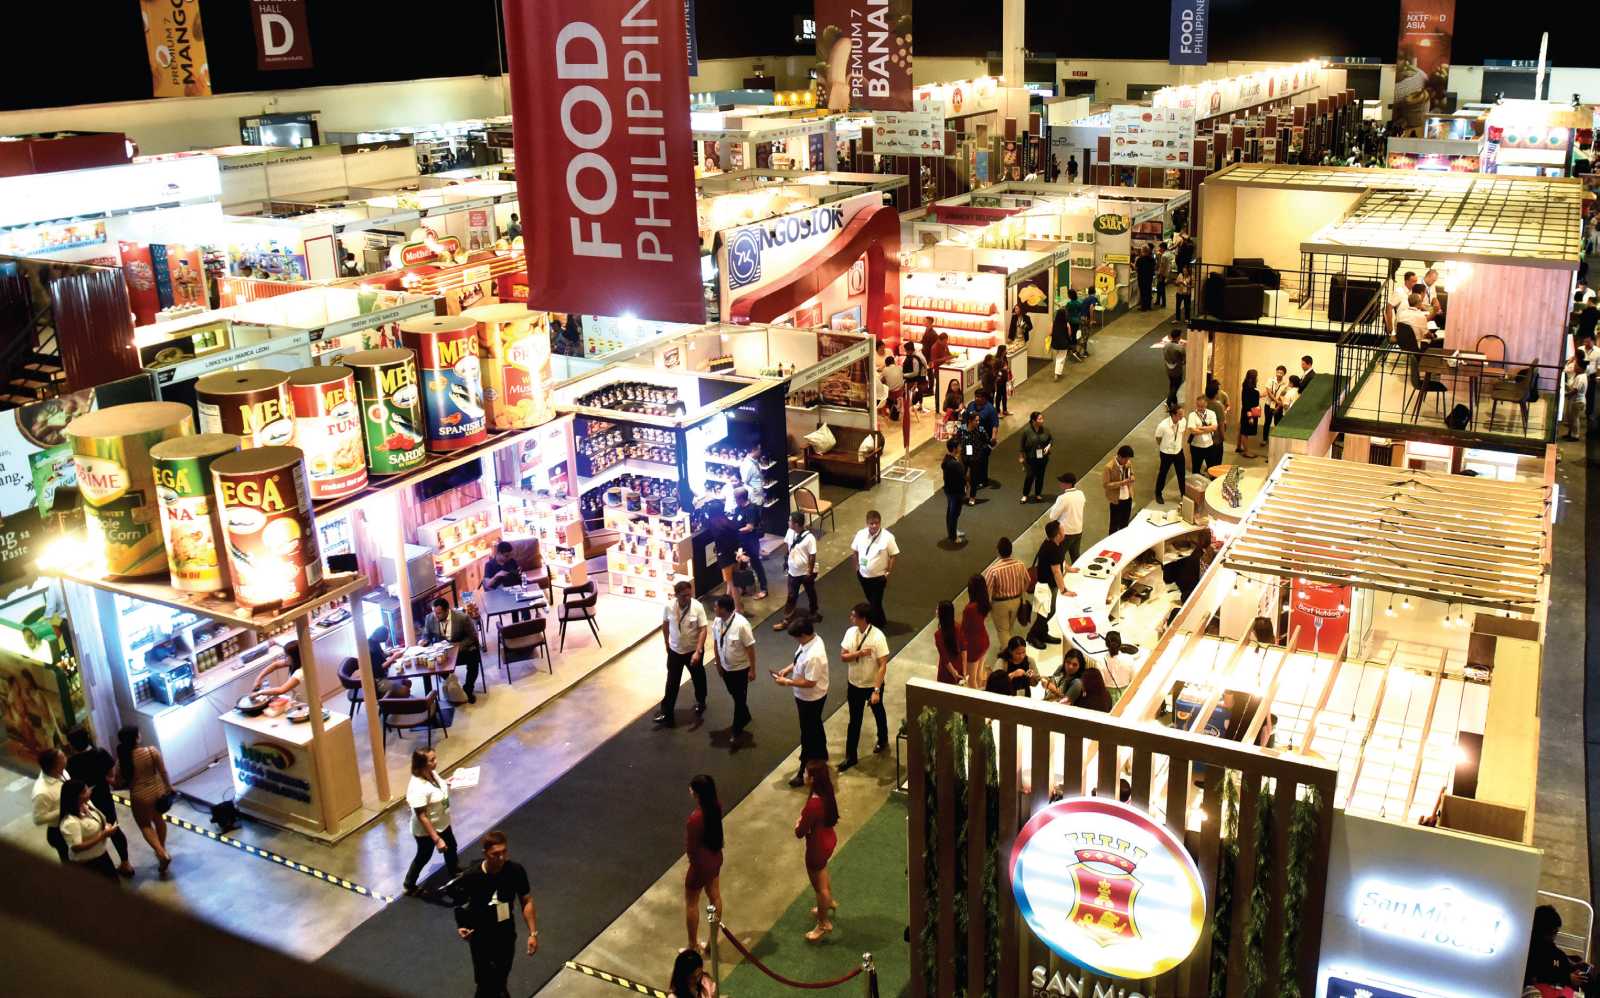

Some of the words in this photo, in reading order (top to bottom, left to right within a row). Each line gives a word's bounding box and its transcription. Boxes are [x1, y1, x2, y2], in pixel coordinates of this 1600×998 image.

[259, 4, 282, 13] HALL
[851, 9, 862, 17] 7
[1180, 9, 1194, 54] FOOD
[1406, 21, 1426, 29] ASIA
[260, 13, 294, 56] D
[866, 0, 890, 98] BANA
[851, 25, 863, 98] PREMIUM
[1345, 56, 1367, 64] EXIT
[1511, 59, 1536, 67] EXIT
[555, 21, 623, 259] FOOD
[759, 204, 844, 249] NGOSIOK
[322, 383, 356, 410] MEG
[240, 396, 294, 434] MEG
[438, 420, 481, 436] SPANISH
[168, 508, 194, 521] NA
[102, 517, 121, 530] ole
[108, 528, 142, 541] Corn
[2, 546, 29, 562] Paste
[1031, 965, 1085, 998] SAN
